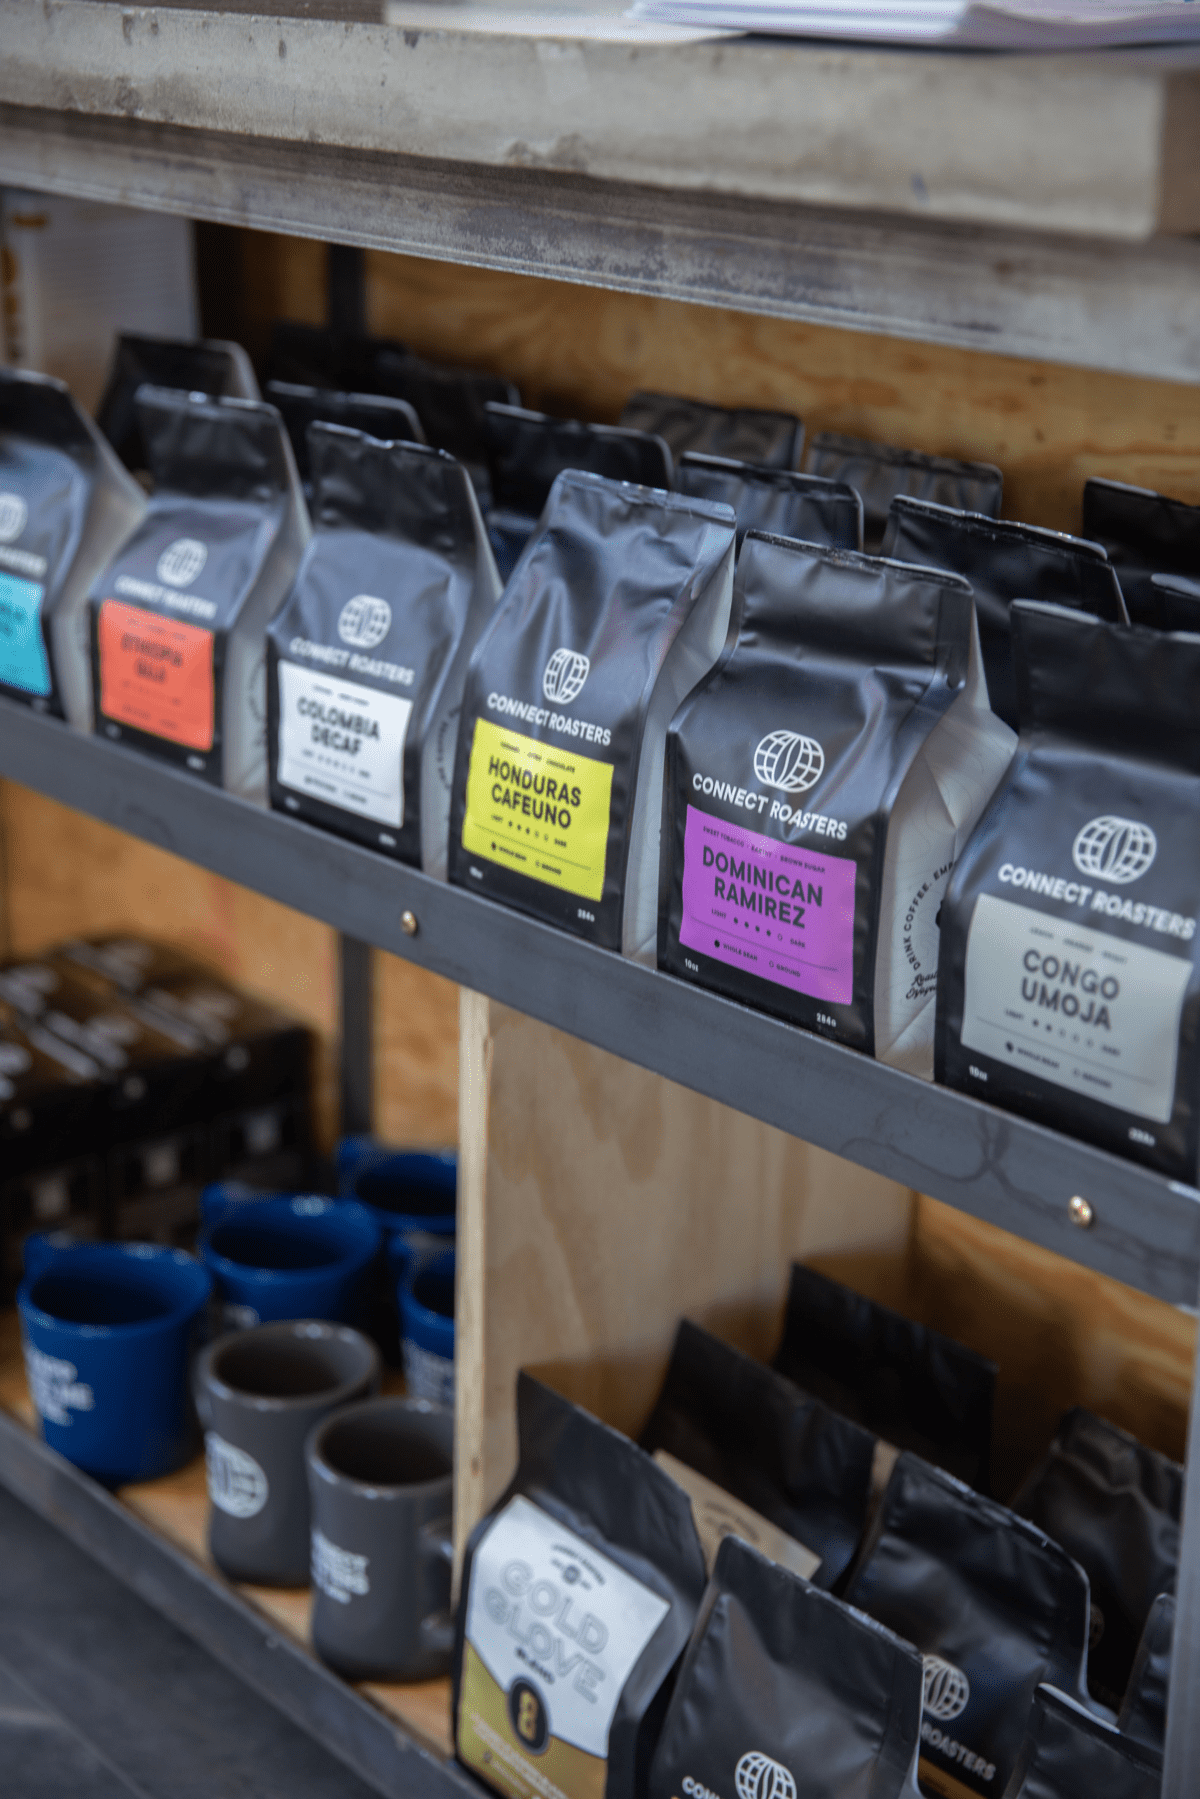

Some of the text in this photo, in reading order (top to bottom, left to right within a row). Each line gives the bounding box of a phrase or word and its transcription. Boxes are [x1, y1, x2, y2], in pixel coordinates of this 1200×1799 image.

[297, 697, 379, 741] COLOMBIA
[311, 724, 362, 756] DECAF
[487, 692, 612, 746] CONNECT ROASTERS
[488, 756, 582, 807] HONDURAS
[491, 783, 571, 829] CAFEUNO
[692, 773, 848, 841] CONNECT ROASTERS
[702, 844, 823, 907] DOMINICAN
[998, 863, 1197, 940] CONNECT ROASTERS
[714, 876, 806, 929] RAMIREZ
[904, 936, 921, 971] DRINK
[1023, 949, 1120, 1001] CONGO
[1021, 978, 1112, 1031] UMOJA
[503, 1558, 610, 1655] GOLD
[483, 1586, 606, 1704] GLOVE
[921, 1722, 996, 1781] ROASTERS
